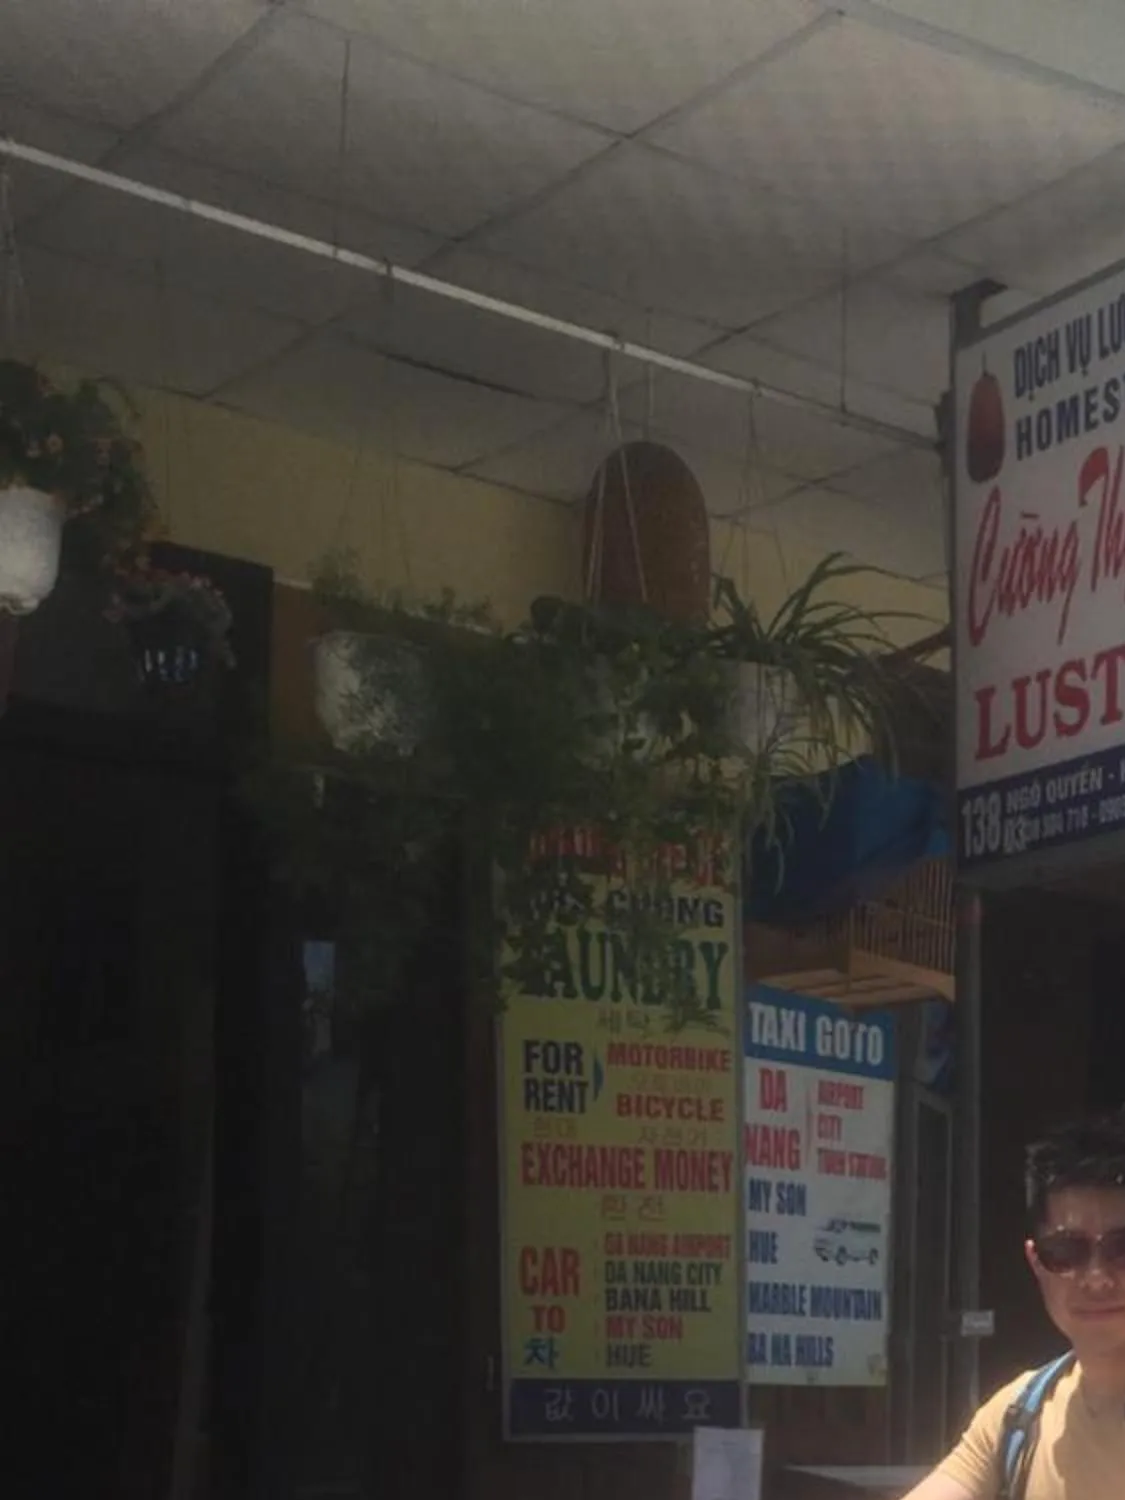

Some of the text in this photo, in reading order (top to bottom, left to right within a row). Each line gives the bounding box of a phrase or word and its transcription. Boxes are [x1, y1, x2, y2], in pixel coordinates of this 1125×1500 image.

[1013, 331, 1060, 400] DỊCH
[1066, 312, 1092, 377] VỤ
[961, 791, 1001, 859] 138
[517, 926, 730, 1010] AUNDRY
[749, 1002, 806, 1053] TAXI
[522, 1040, 584, 1076] FOR
[607, 1043, 732, 1073] MOTORBIKE
[523, 1078, 588, 1114] RENT
[616, 1093, 725, 1122] BICYCLE
[759, 1068, 788, 1113] DA
[745, 1124, 800, 1172] NANG
[520, 1141, 733, 1193] EXCHANGE MONEY
[749, 1178, 807, 1216] MY SON
[749, 1229, 779, 1264] HUE
[519, 1245, 580, 1297] CAR
[604, 1260, 723, 1286] DA NANG CITY
[604, 1288, 712, 1313] BANA HILL
[749, 1281, 806, 1316] MARBLE
[530, 1304, 567, 1334] TO
[605, 1315, 683, 1341] MY SON
[523, 1336, 560, 1369] 차
[605, 1343, 653, 1369] HUE
